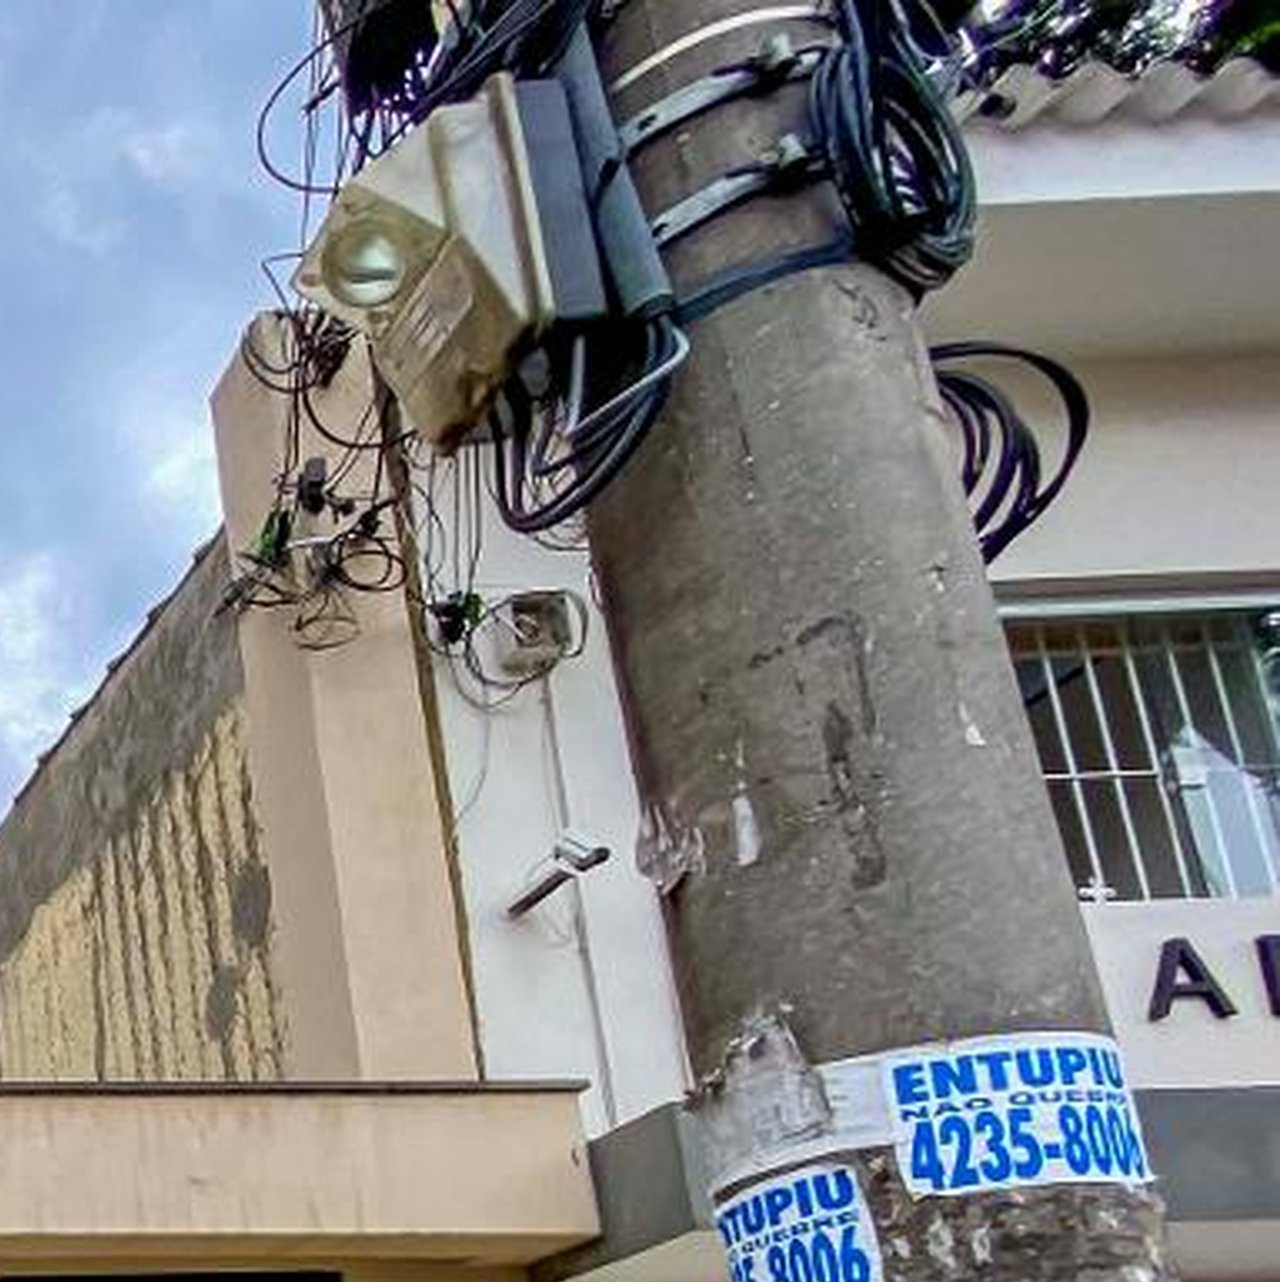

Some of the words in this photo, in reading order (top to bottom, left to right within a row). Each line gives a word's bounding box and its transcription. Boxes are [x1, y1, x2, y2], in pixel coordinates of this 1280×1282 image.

[893, 1047, 1124, 1105] ENTUPIU
[911, 1105, 1144, 1190] 4235-8006
[719, 1169, 854, 1247] TUPIU
